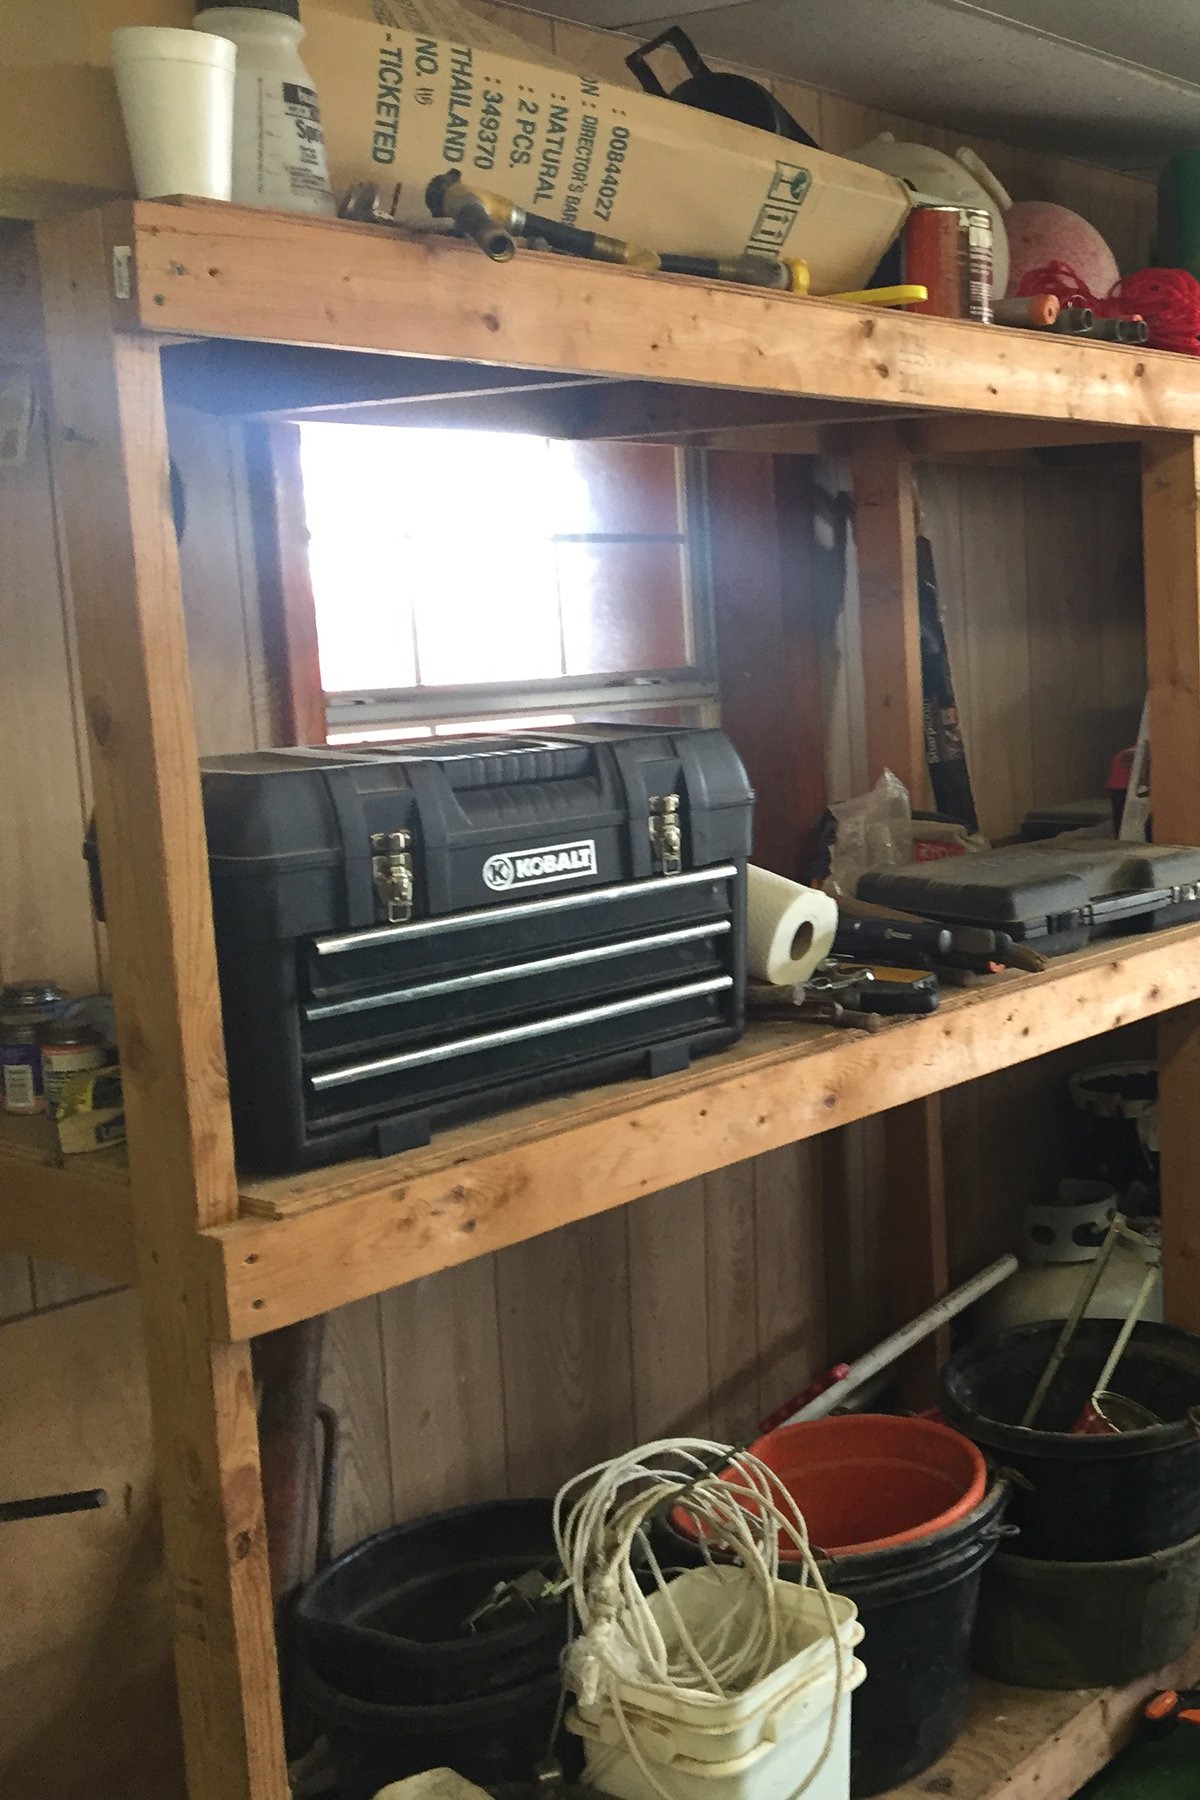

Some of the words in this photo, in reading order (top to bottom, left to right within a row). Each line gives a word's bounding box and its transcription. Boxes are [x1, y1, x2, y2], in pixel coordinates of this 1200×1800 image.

[414, 37, 439, 77] NO.
[371, 47, 403, 165] TICKETED
[442, 46, 473, 164] THAILAND
[473, 89, 504, 171] 349370
[508, 118, 536, 169] PCS.
[517, 98, 540, 115] 2
[532, 103, 570, 205] NATURAL
[569, 115, 600, 194] DIRECTOR'S
[593, 125, 630, 223] 00844027
[515, 848, 592, 878] KOBALT
